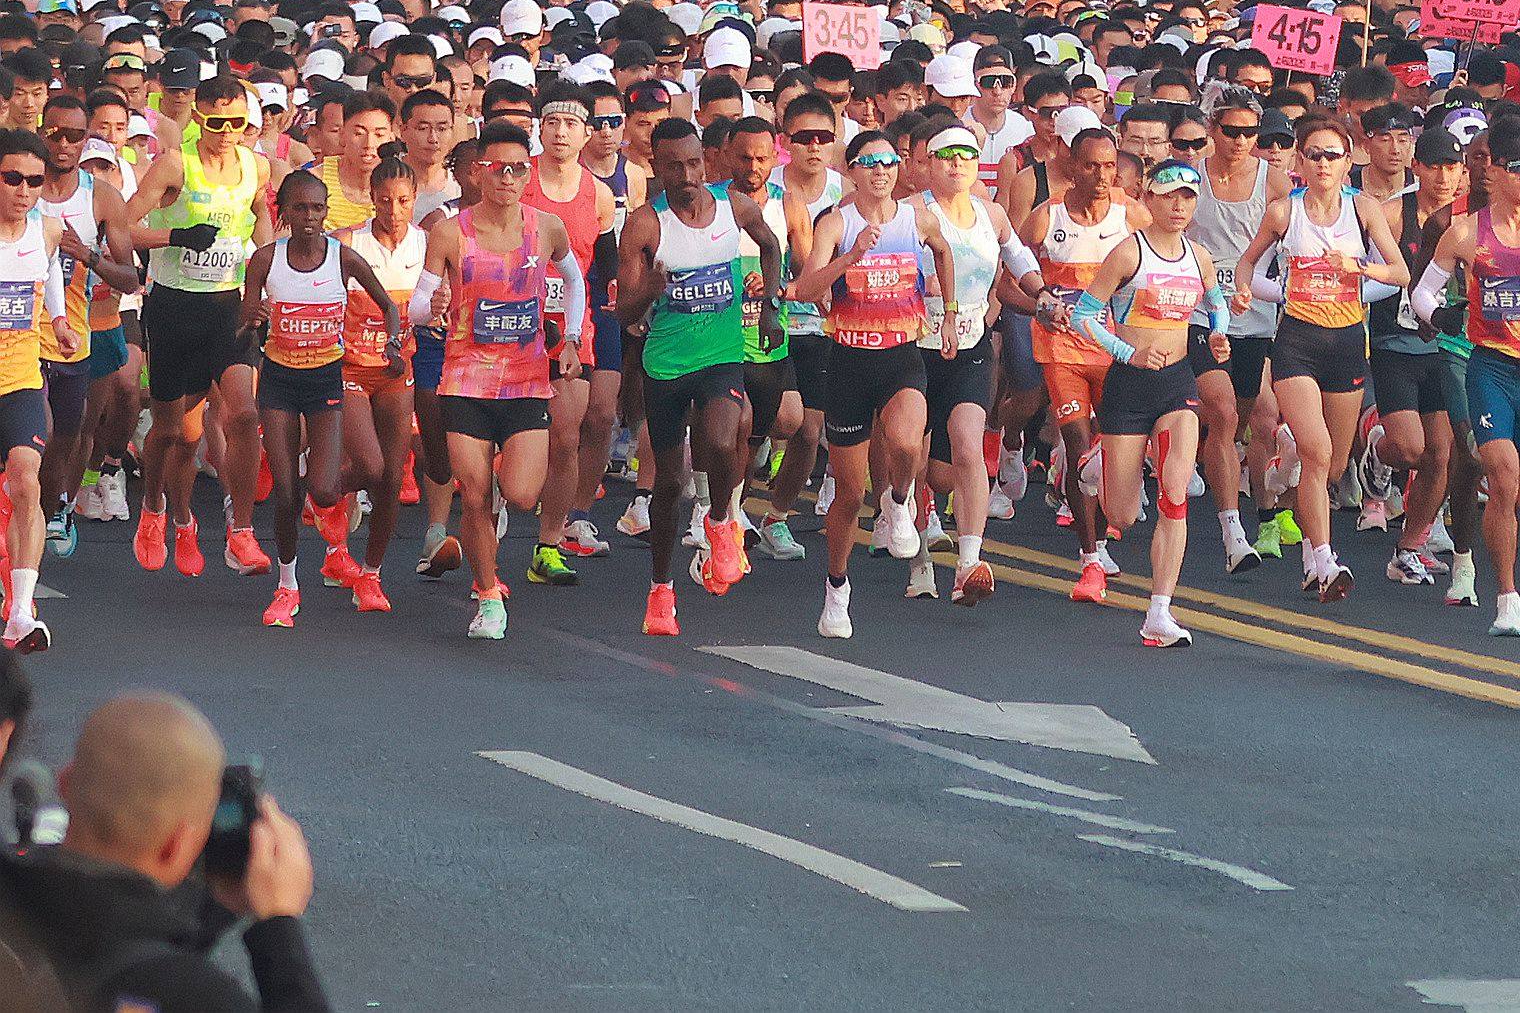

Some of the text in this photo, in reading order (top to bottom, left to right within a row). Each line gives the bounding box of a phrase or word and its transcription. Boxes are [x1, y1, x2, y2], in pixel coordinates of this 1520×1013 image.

[815, 9, 869, 50] 3:45
[1267, 13, 1324, 55] 4:15
[672, 279, 733, 301] GELETA
[867, 270, 900, 288] 姚妙
